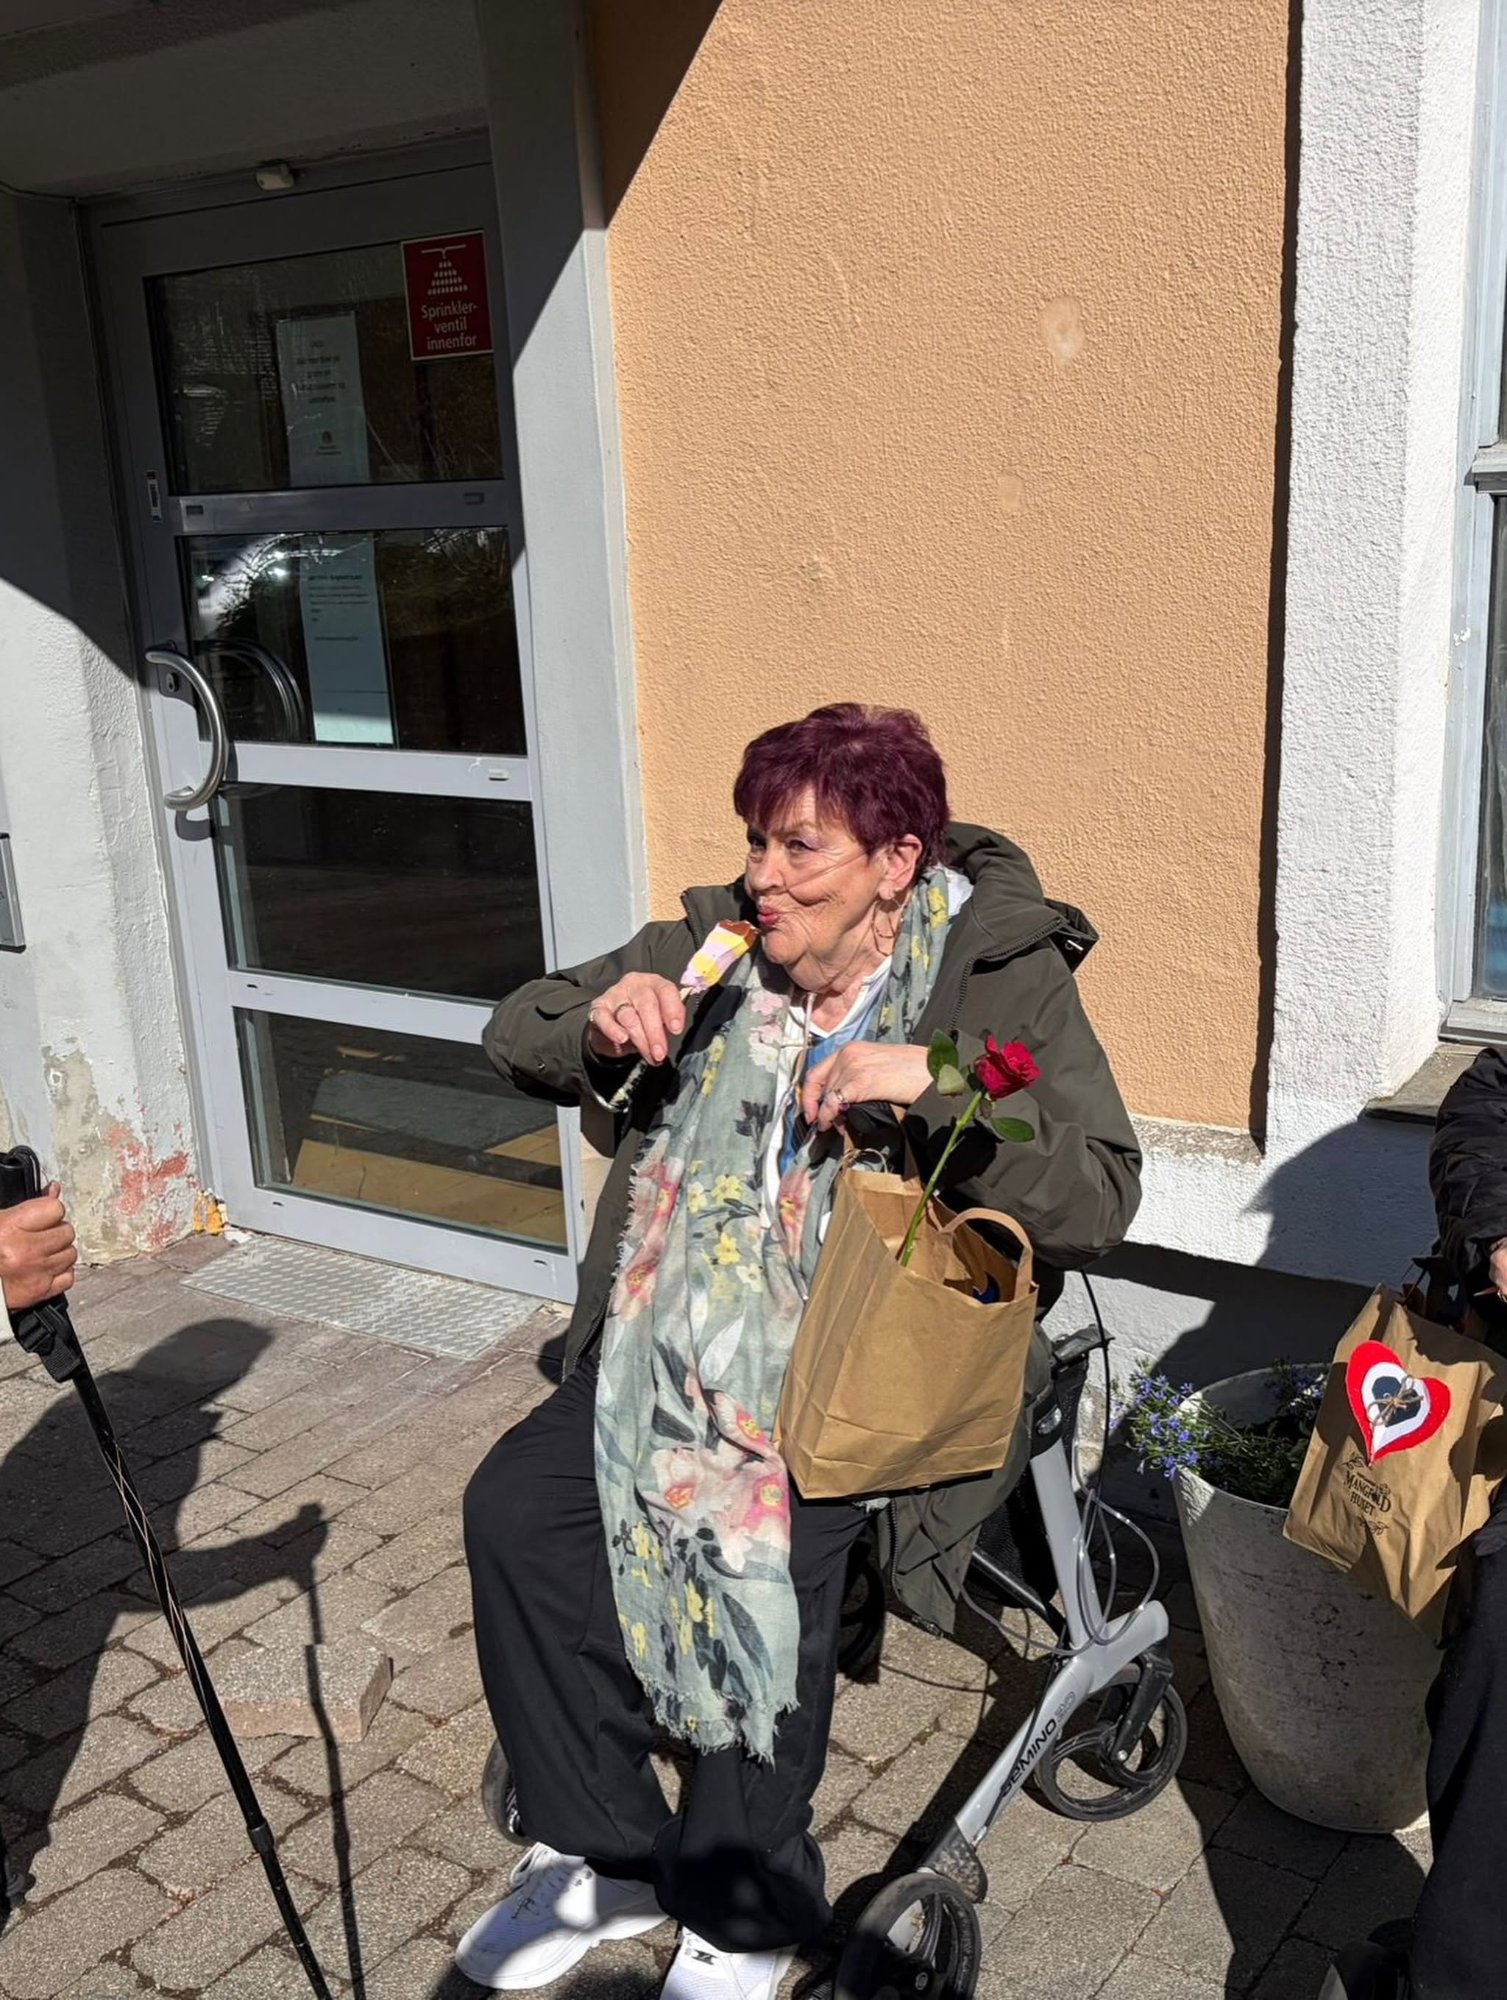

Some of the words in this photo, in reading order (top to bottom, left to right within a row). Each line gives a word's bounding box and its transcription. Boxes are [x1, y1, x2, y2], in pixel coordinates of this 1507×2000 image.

[421, 301, 477, 320] Sprinkler-
[434, 317, 467, 334] ventil
[427, 334, 477, 350] innenfor
